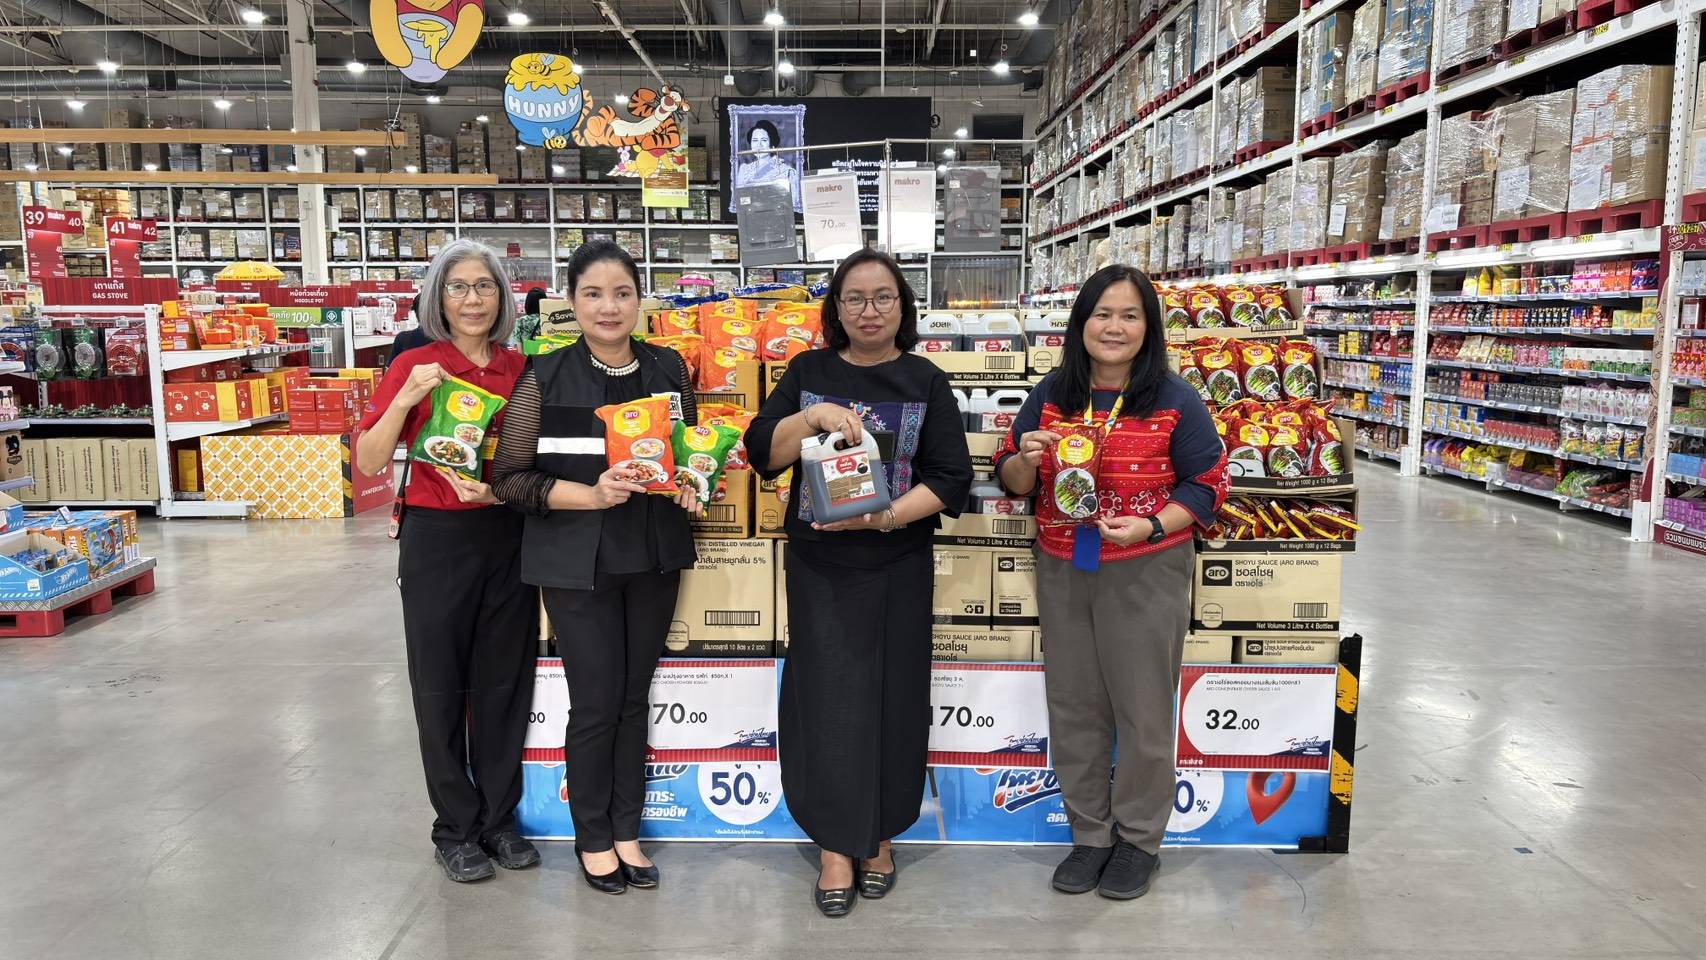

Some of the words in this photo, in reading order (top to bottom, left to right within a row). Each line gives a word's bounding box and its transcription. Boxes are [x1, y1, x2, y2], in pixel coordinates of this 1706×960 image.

[508, 94, 579, 118] HUNNY
[816, 184, 842, 193] makro
[26, 211, 44, 225] 39
[68, 218, 81, 226] 40
[110, 222, 125, 234] 41
[144, 227, 156, 235] 42
[94, 280, 124, 290] เตาแก๊ส
[460, 396, 476, 406] aro
[624, 410, 638, 418] aro
[695, 426, 709, 435] aro
[1285, 479, 1299, 487] Weight
[1327, 477, 1338, 485] Bags
[1288, 542, 1304, 550] Weight
[1208, 569, 1226, 577] aro
[1235, 566, 1274, 579] ซอสโชยุ
[653, 703, 707, 724] 70.00
[1205, 709, 1260, 730] 32.00
